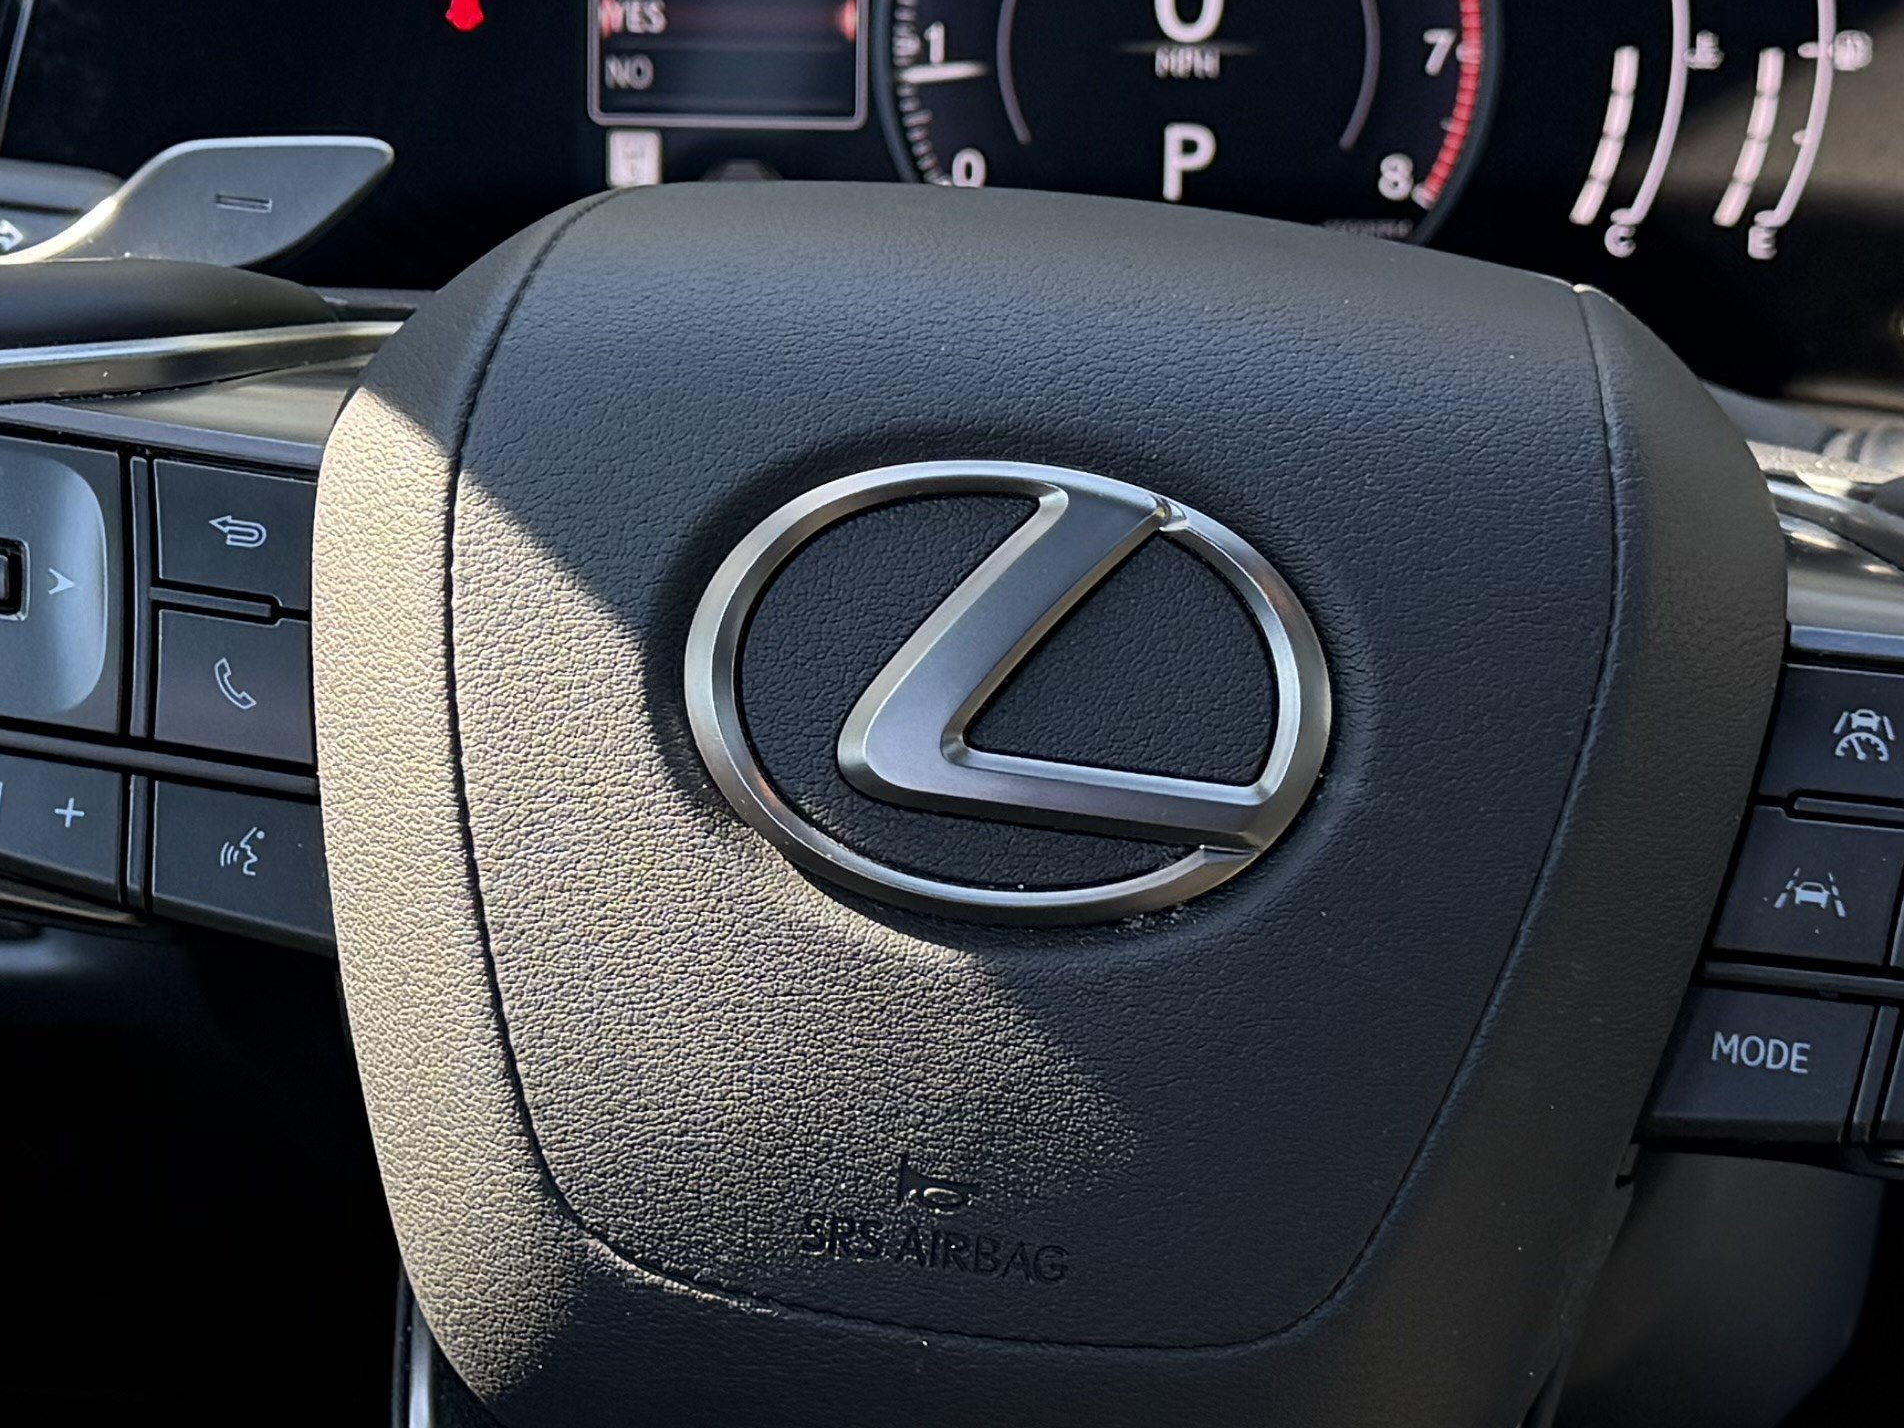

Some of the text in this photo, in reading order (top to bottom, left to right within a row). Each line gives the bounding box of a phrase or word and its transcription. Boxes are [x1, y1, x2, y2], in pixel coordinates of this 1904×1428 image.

[924, 21, 946, 64] 1
[1154, 46, 1221, 79] MPH
[1422, 28, 1457, 76] 7
[604, 53, 654, 90] NO
[951, 147, 987, 188] 0
[1162, 121, 1217, 202] P
[1377, 153, 1414, 202] 8
[1711, 1031, 1811, 1075] MODE
[798, 1213, 1071, 1284] SRS AIRBAG
